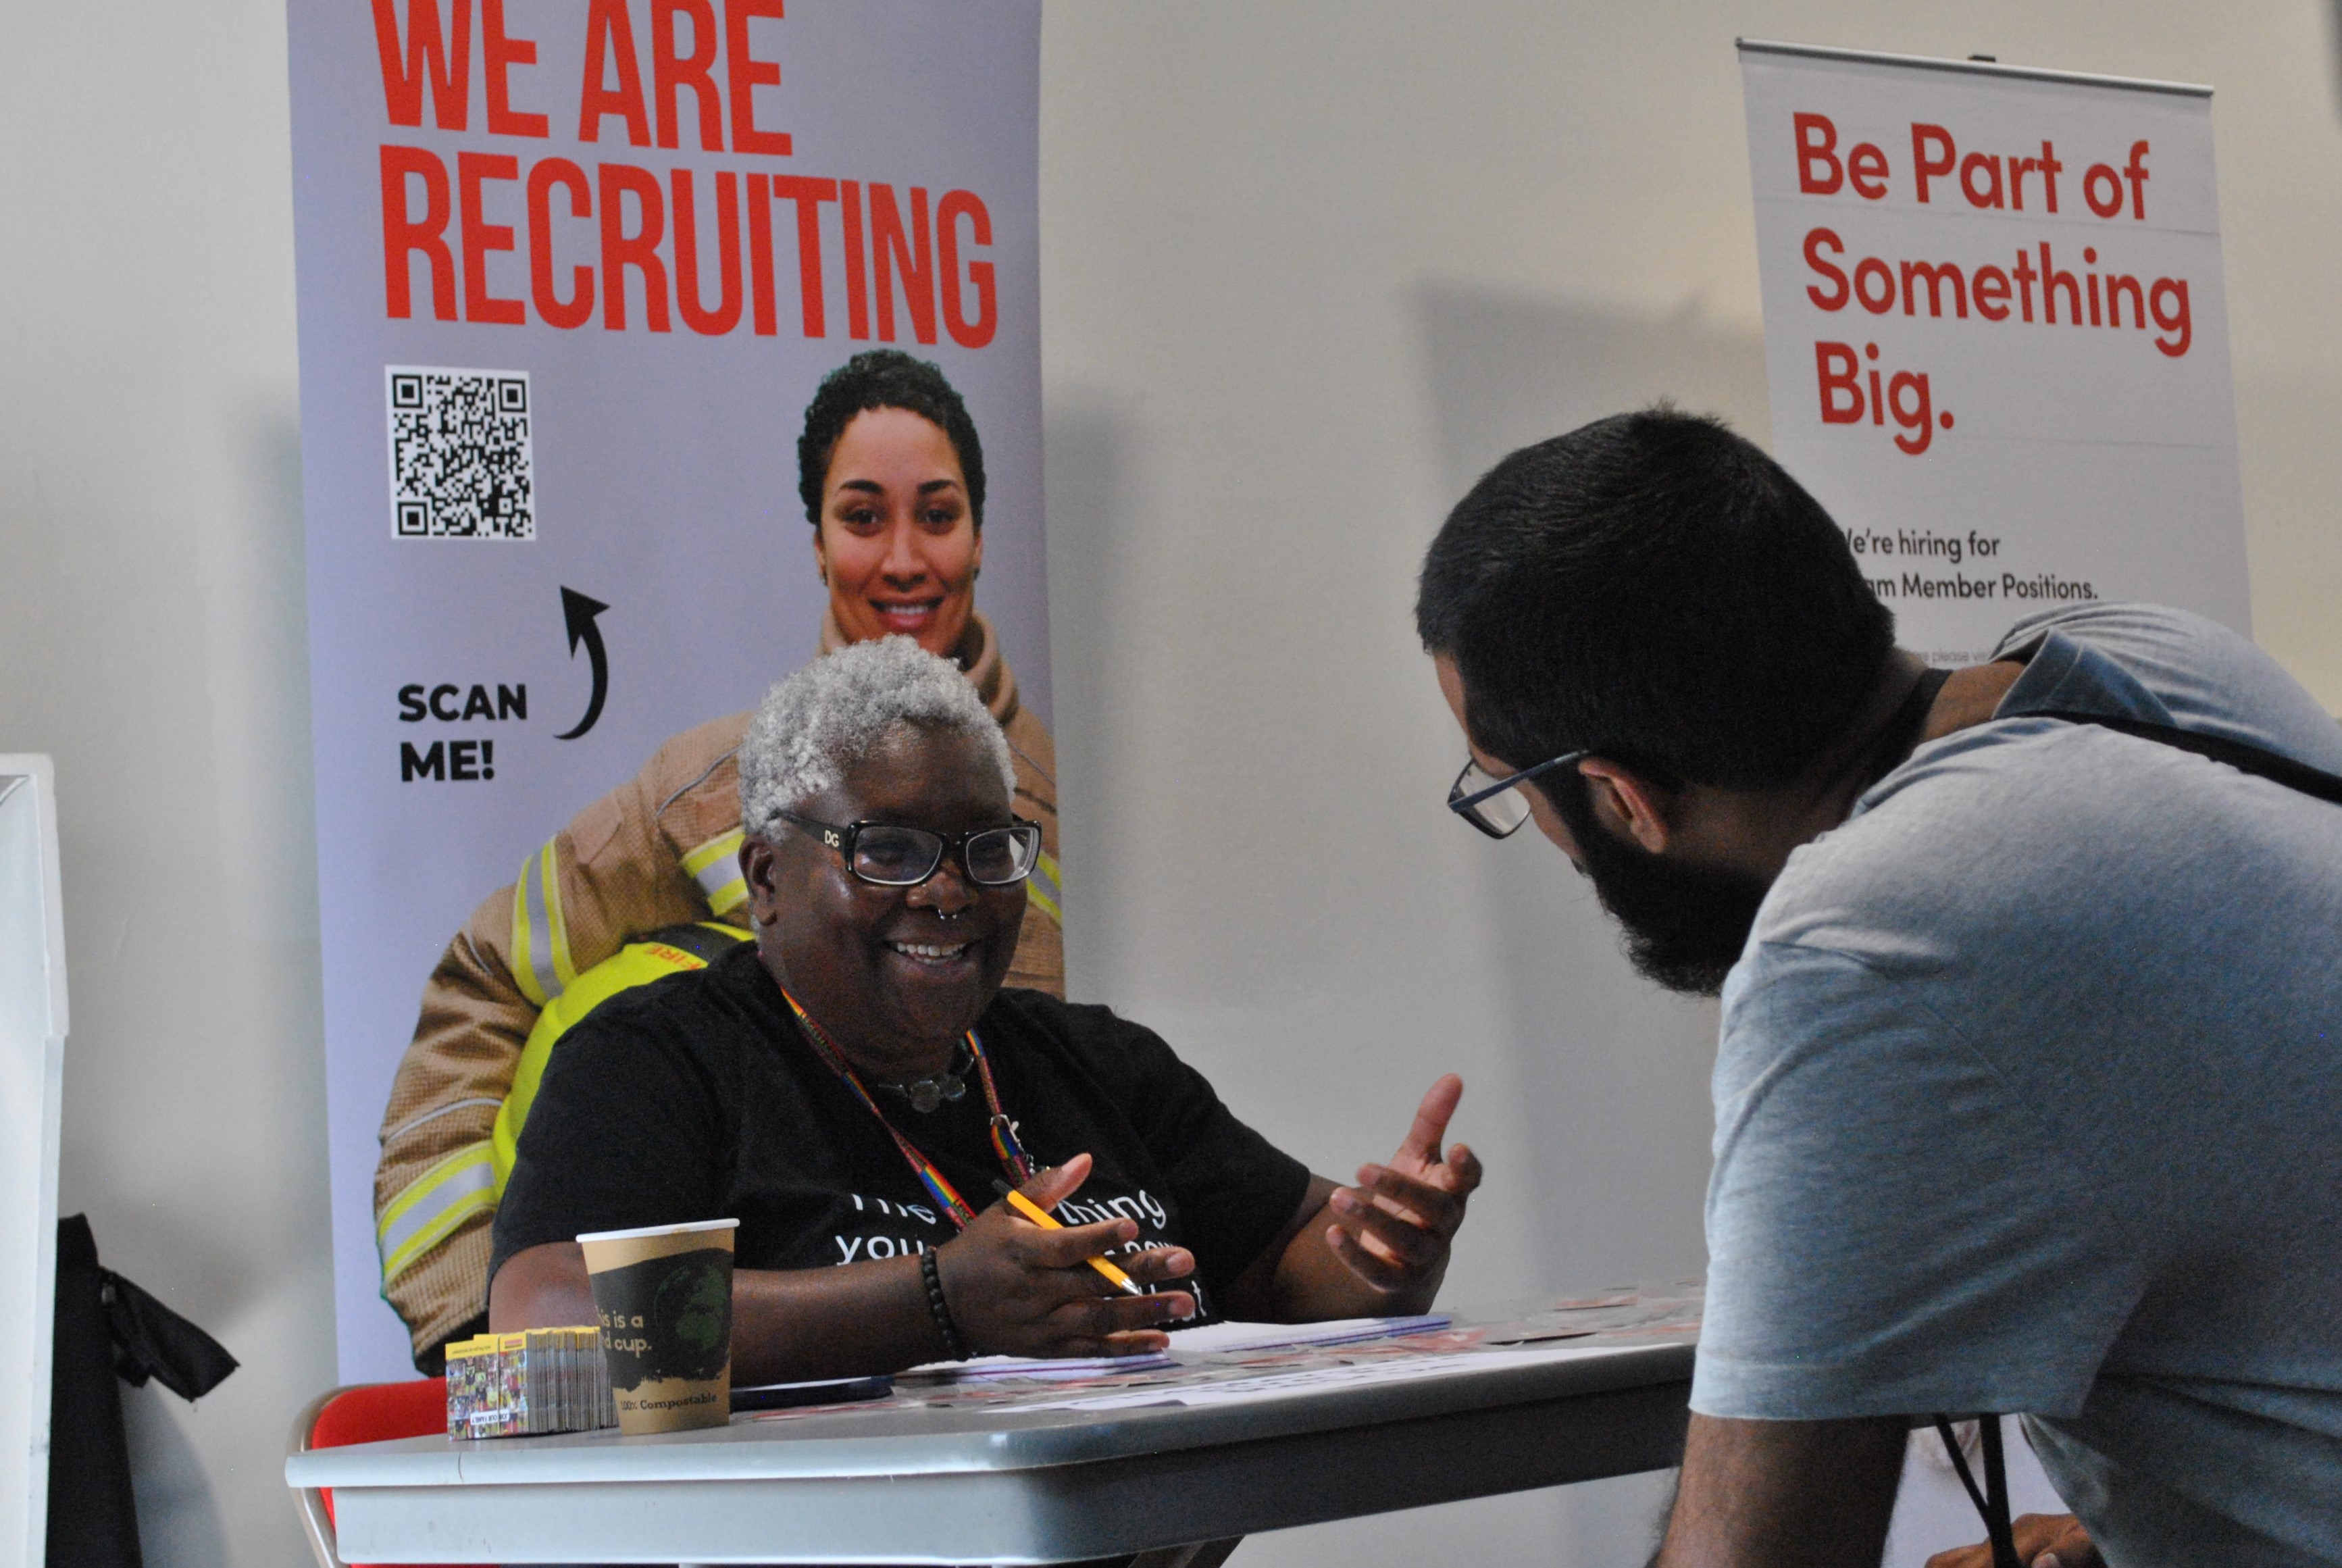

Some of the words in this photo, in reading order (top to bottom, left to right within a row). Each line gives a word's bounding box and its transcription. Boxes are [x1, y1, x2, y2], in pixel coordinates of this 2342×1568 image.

[370, 0, 550, 138] WE
[578, 0, 793, 157] ARE
[1793, 112, 1890, 201] Be
[1910, 122, 2063, 213] Part
[2083, 140, 2149, 220] of
[379, 144, 998, 349] RECRUITING
[1803, 227, 2193, 358] Something
[1814, 341, 1954, 455] Big.
[1898, 528, 1962, 563] hiring
[1968, 530, 2000, 556] for
[1902, 572, 1997, 598] Member
[2002, 573, 2098, 600] Positions.
[398, 684, 528, 722] SCAN
[400, 740, 494, 782] ME!
[824, 830, 840, 848] DG
[613, 1309, 626, 1329] is
[630, 1315, 644, 1329] a
[614, 1338, 652, 1359] cup.
[640, 1392, 718, 1410] Compostable
